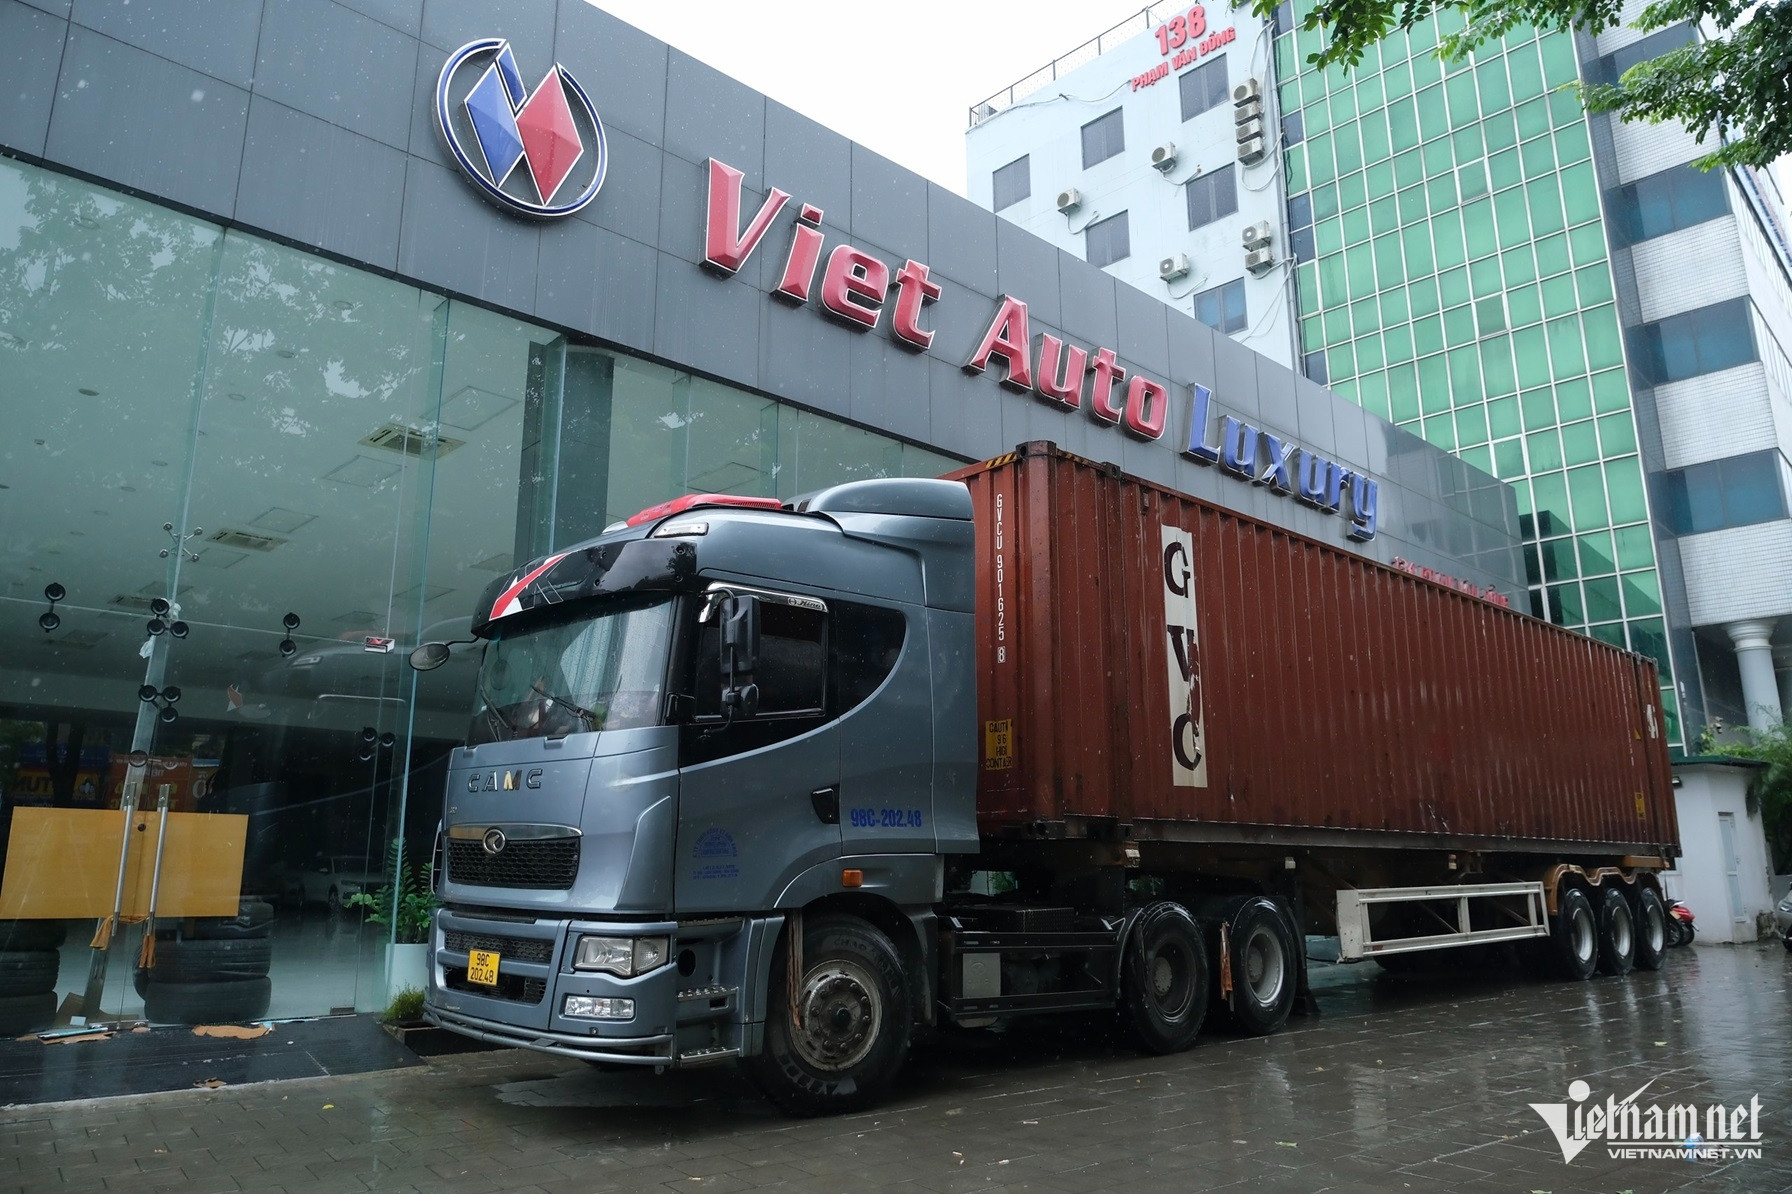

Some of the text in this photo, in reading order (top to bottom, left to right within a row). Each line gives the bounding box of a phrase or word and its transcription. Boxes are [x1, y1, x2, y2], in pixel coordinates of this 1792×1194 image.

[1154, 5, 1206, 56] 138
[1131, 61, 1169, 92] PHẠM
[1171, 47, 1197, 70] VĂN
[702, 156, 1378, 542] Viet Auto Luxury
[996, 554, 1005, 641] 901625
[467, 768, 543, 793] CAMC
[850, 808, 922, 828] 98C-202.48
[470, 966, 494, 983] 202.48
[476, 952, 490, 967] 98C
